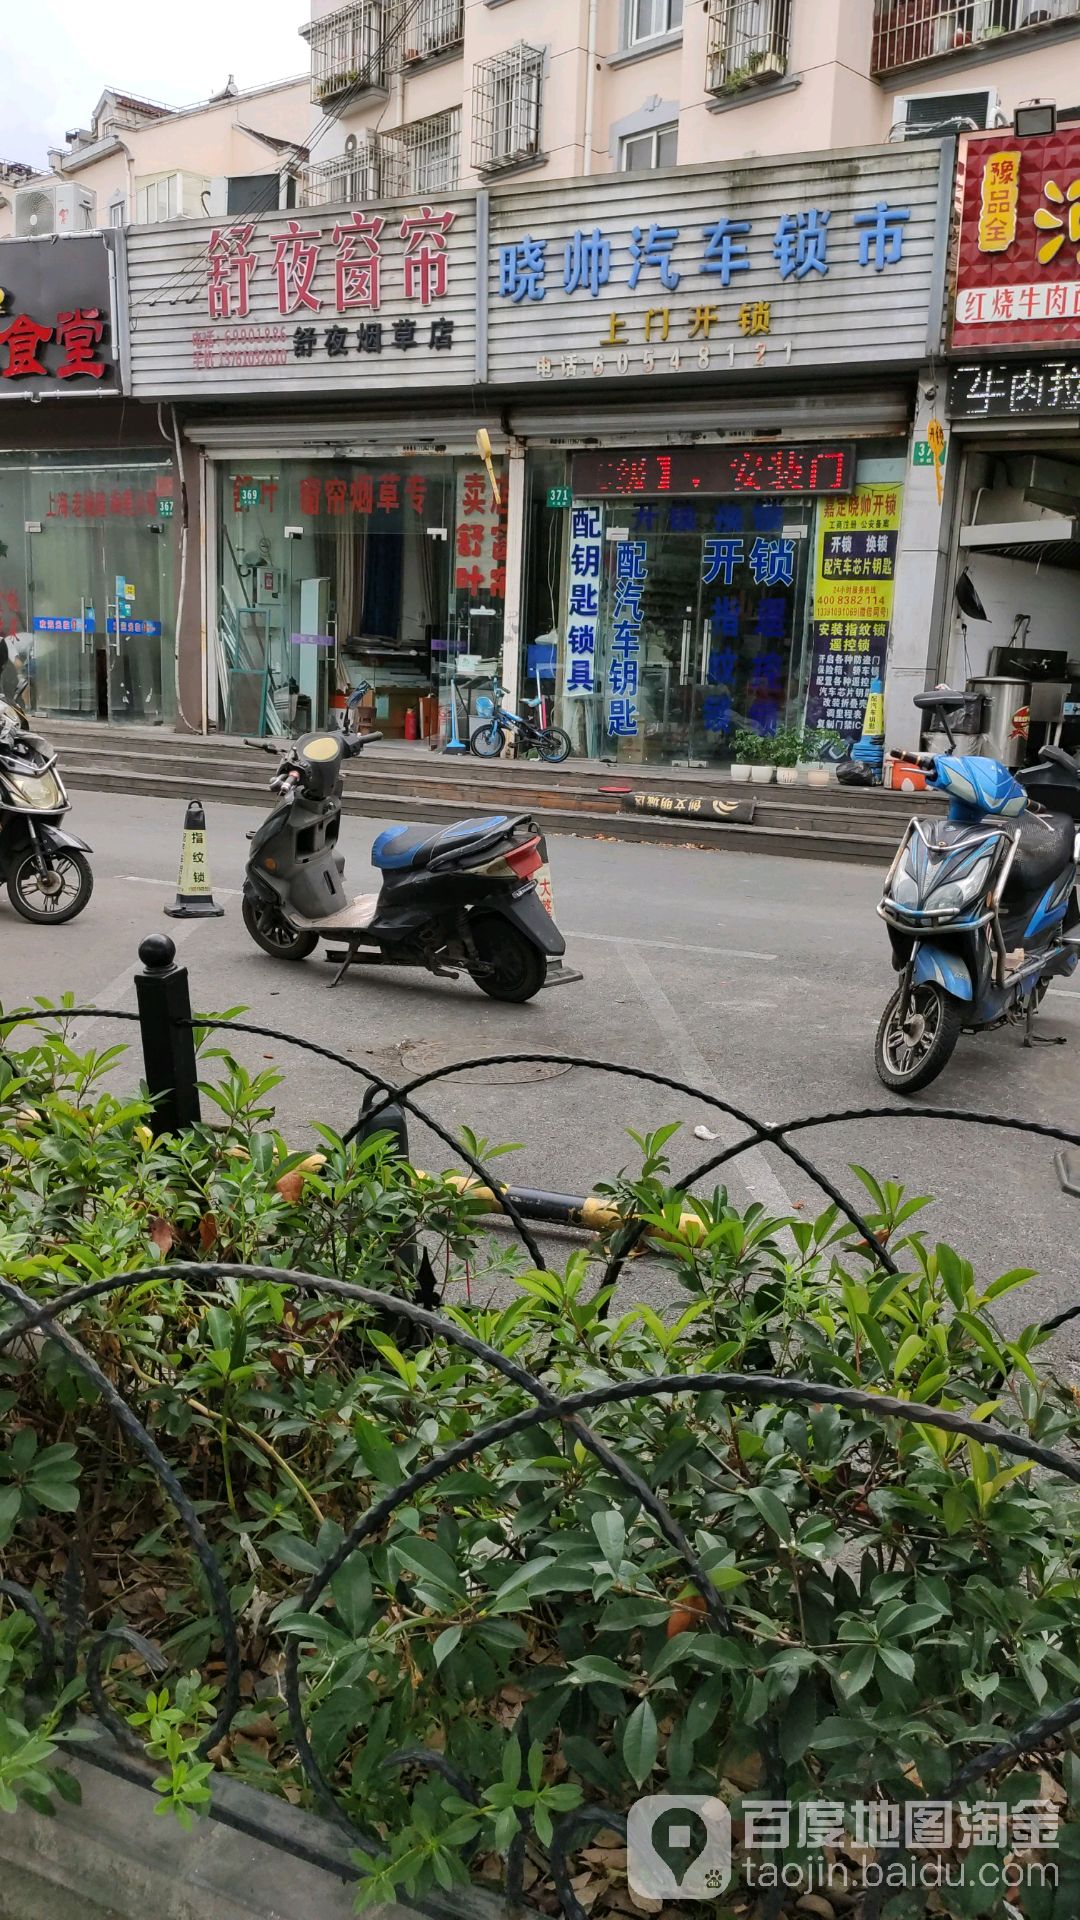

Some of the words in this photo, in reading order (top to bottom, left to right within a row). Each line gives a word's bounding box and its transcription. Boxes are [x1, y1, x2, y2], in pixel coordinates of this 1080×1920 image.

[499, 201, 910, 303] 晓帅汽车锁市
[206, 205, 457, 319] 舒夜窗帘
[600, 301, 773, 345] 上门开锁
[293, 317, 454, 358] 舒夜烟草店
[242, 489, 258, 500] 369
[550, 489, 568, 501] 371
[159, 501, 174, 511] 367
[823, 493, 897, 518] 嘉定晓帅开锁
[831, 536, 852, 553] 开锁
[866, 534, 888, 553] 换锁
[702, 537, 796, 587] 开锁
[823, 557, 892, 576] 配汽车芯片钥匙
[567, 506, 600, 691] 配钥匙锁具
[818, 596, 835, 606] 400
[837, 595, 863, 605] 8382
[866, 595, 885, 605] 114
[608, 541, 648, 737] 配汽车钥匙
[819, 622, 886, 637] 安装指纹锁
[829, 638, 870, 652] 遥控锁
[819, 654, 880, 665] 开启各种防盗门
[816, 676, 872, 687] 配置各种遥控
[826, 709, 862, 719] 调里程表
[816, 719, 863, 730] 复制门禁IC
[191, 832, 205, 883] 指纹锁
